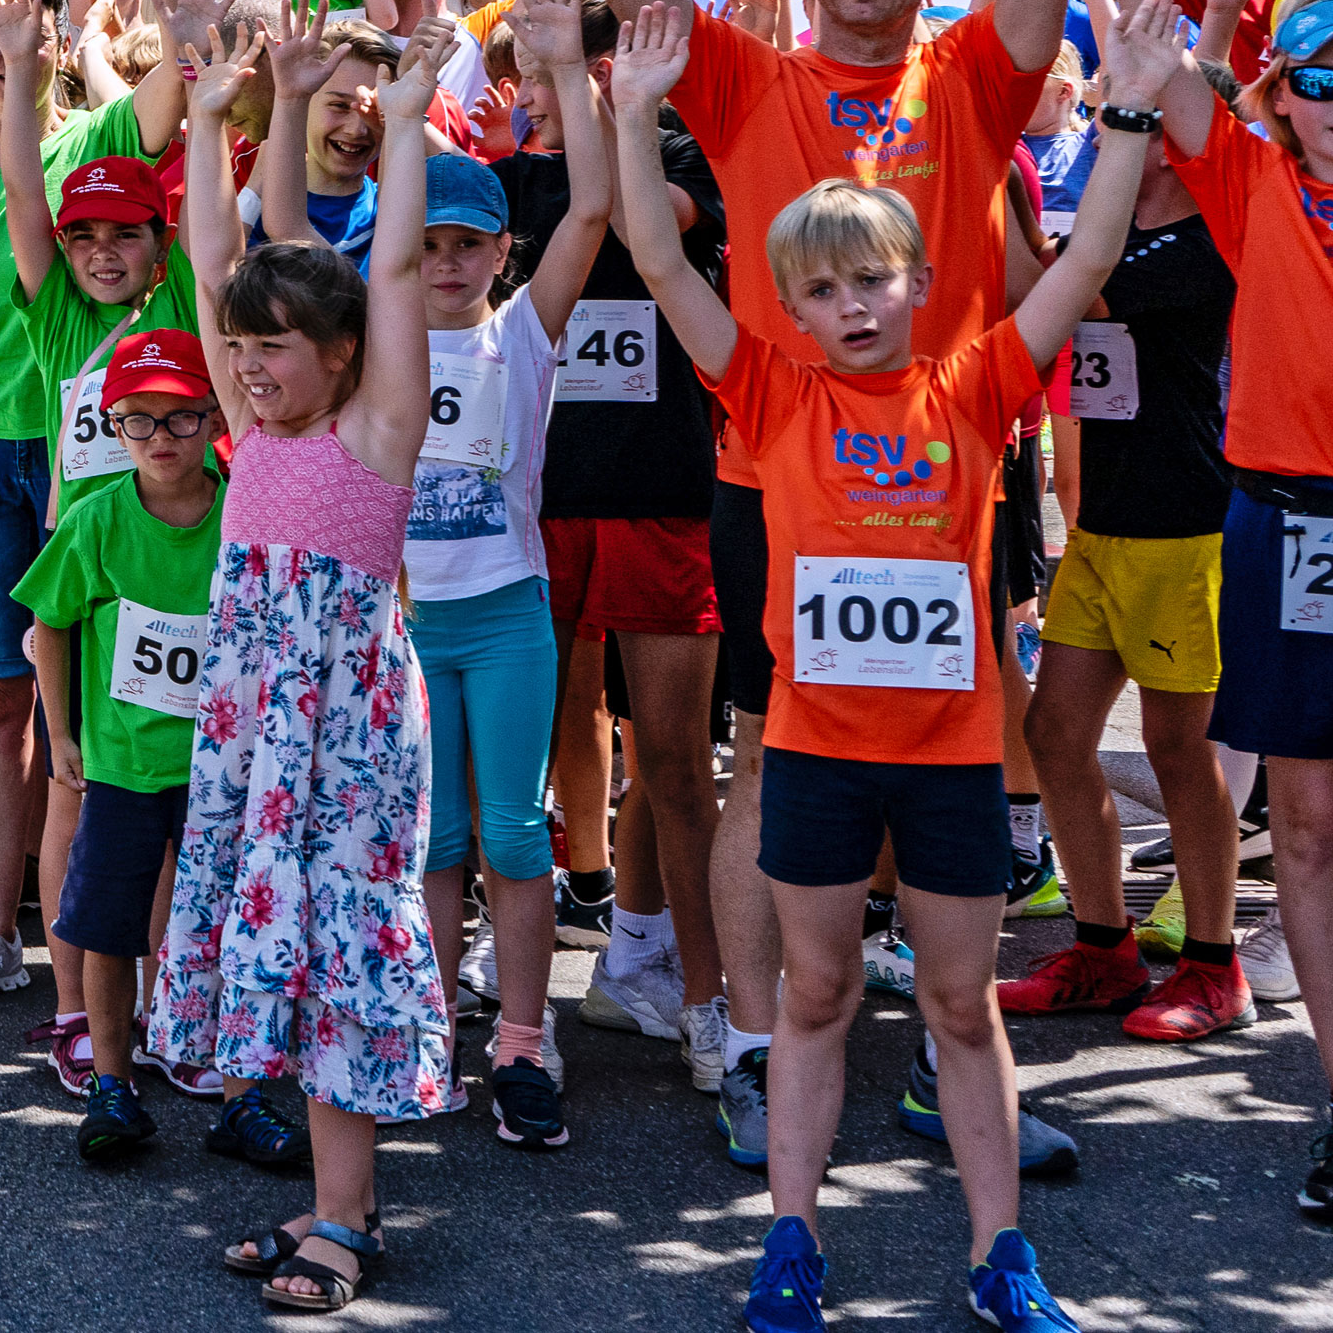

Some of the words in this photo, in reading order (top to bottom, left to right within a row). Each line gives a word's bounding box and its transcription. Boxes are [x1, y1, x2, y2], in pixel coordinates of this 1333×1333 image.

[826, 91, 893, 127] tsv
[843, 140, 930, 162] weingarten
[557, 329, 646, 368] 46
[430, 385, 462, 426] 6
[832, 427, 907, 467] tsv
[846, 488, 948, 507] weingarten
[862, 512, 904, 527] alles
[830, 567, 896, 586] Alltech
[145, 619, 198, 639] Alltech
[798, 593, 963, 647] 1002
[132, 634, 199, 686] 50
